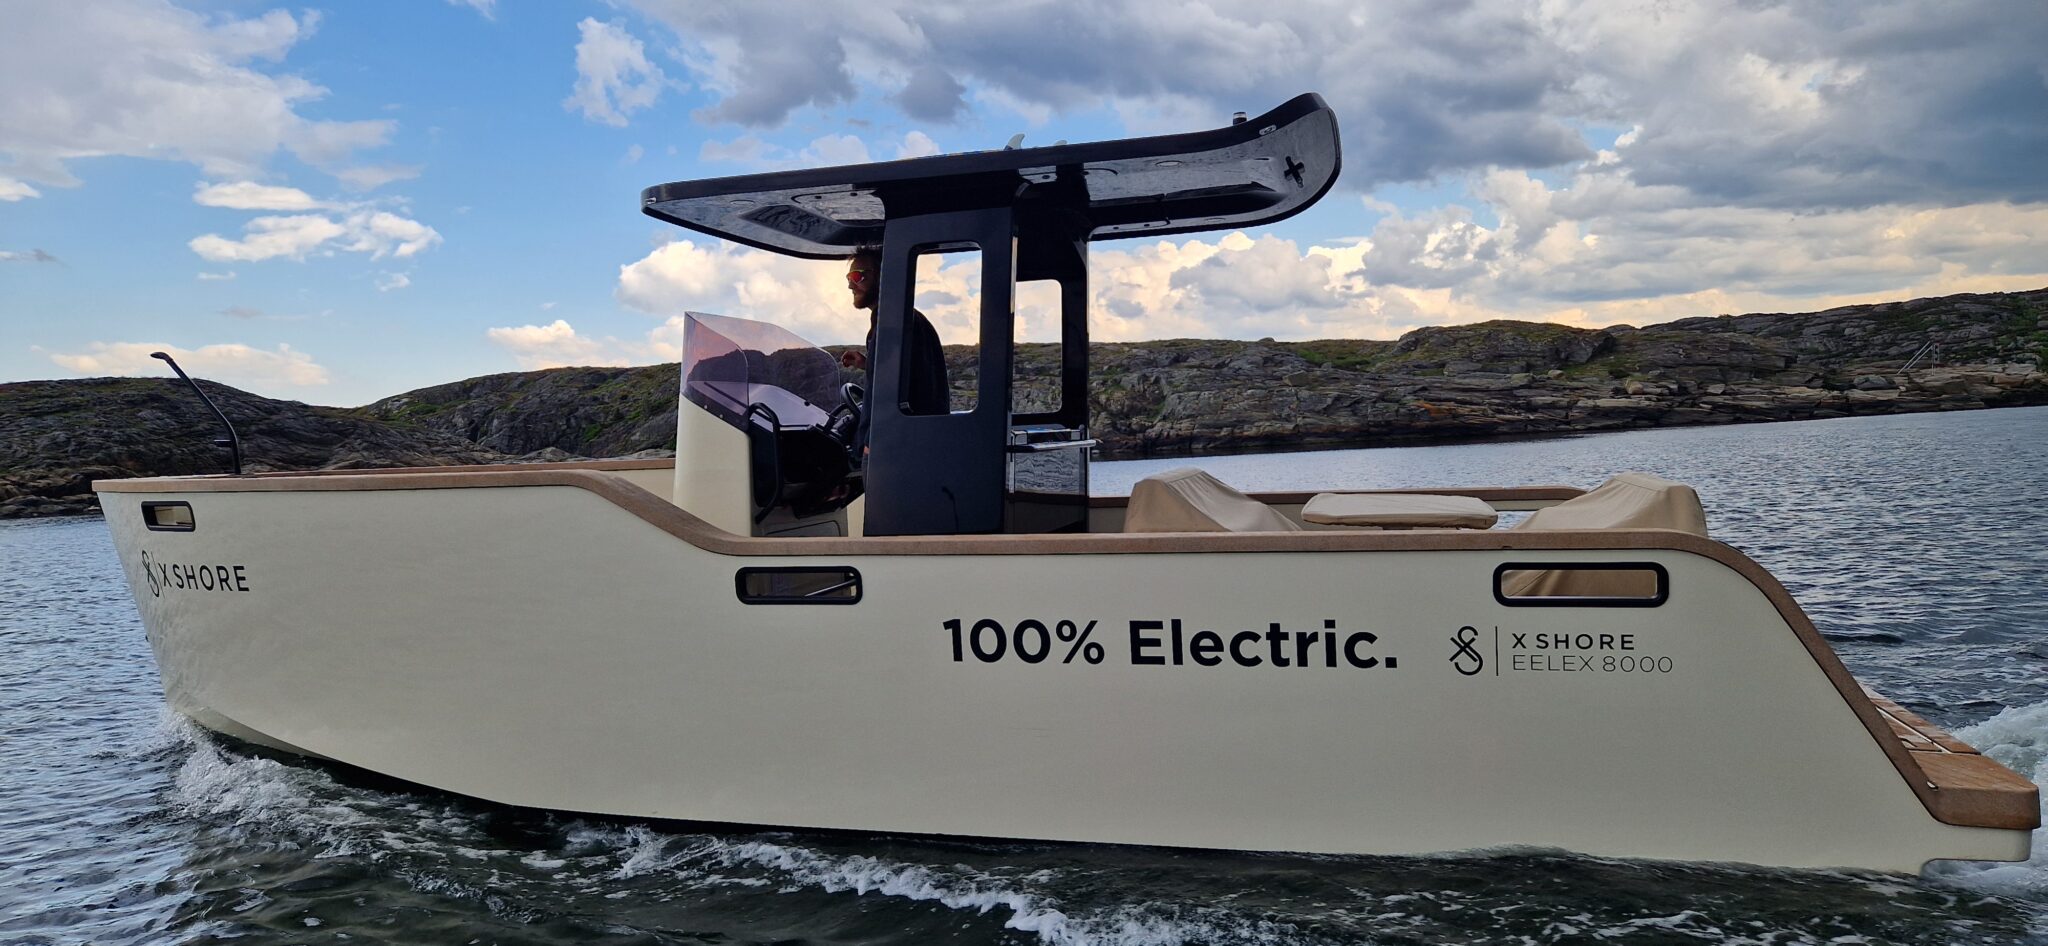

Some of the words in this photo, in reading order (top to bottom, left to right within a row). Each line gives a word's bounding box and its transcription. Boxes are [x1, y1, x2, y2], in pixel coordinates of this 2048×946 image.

[942, 618, 1106, 665] 100%
[1128, 618, 1399, 670] Electric.
[1511, 632, 1528, 650] X
[1535, 632, 1636, 651] SHORE
[1511, 654, 1595, 673] EELEX
[1601, 655, 1674, 674] 8000
